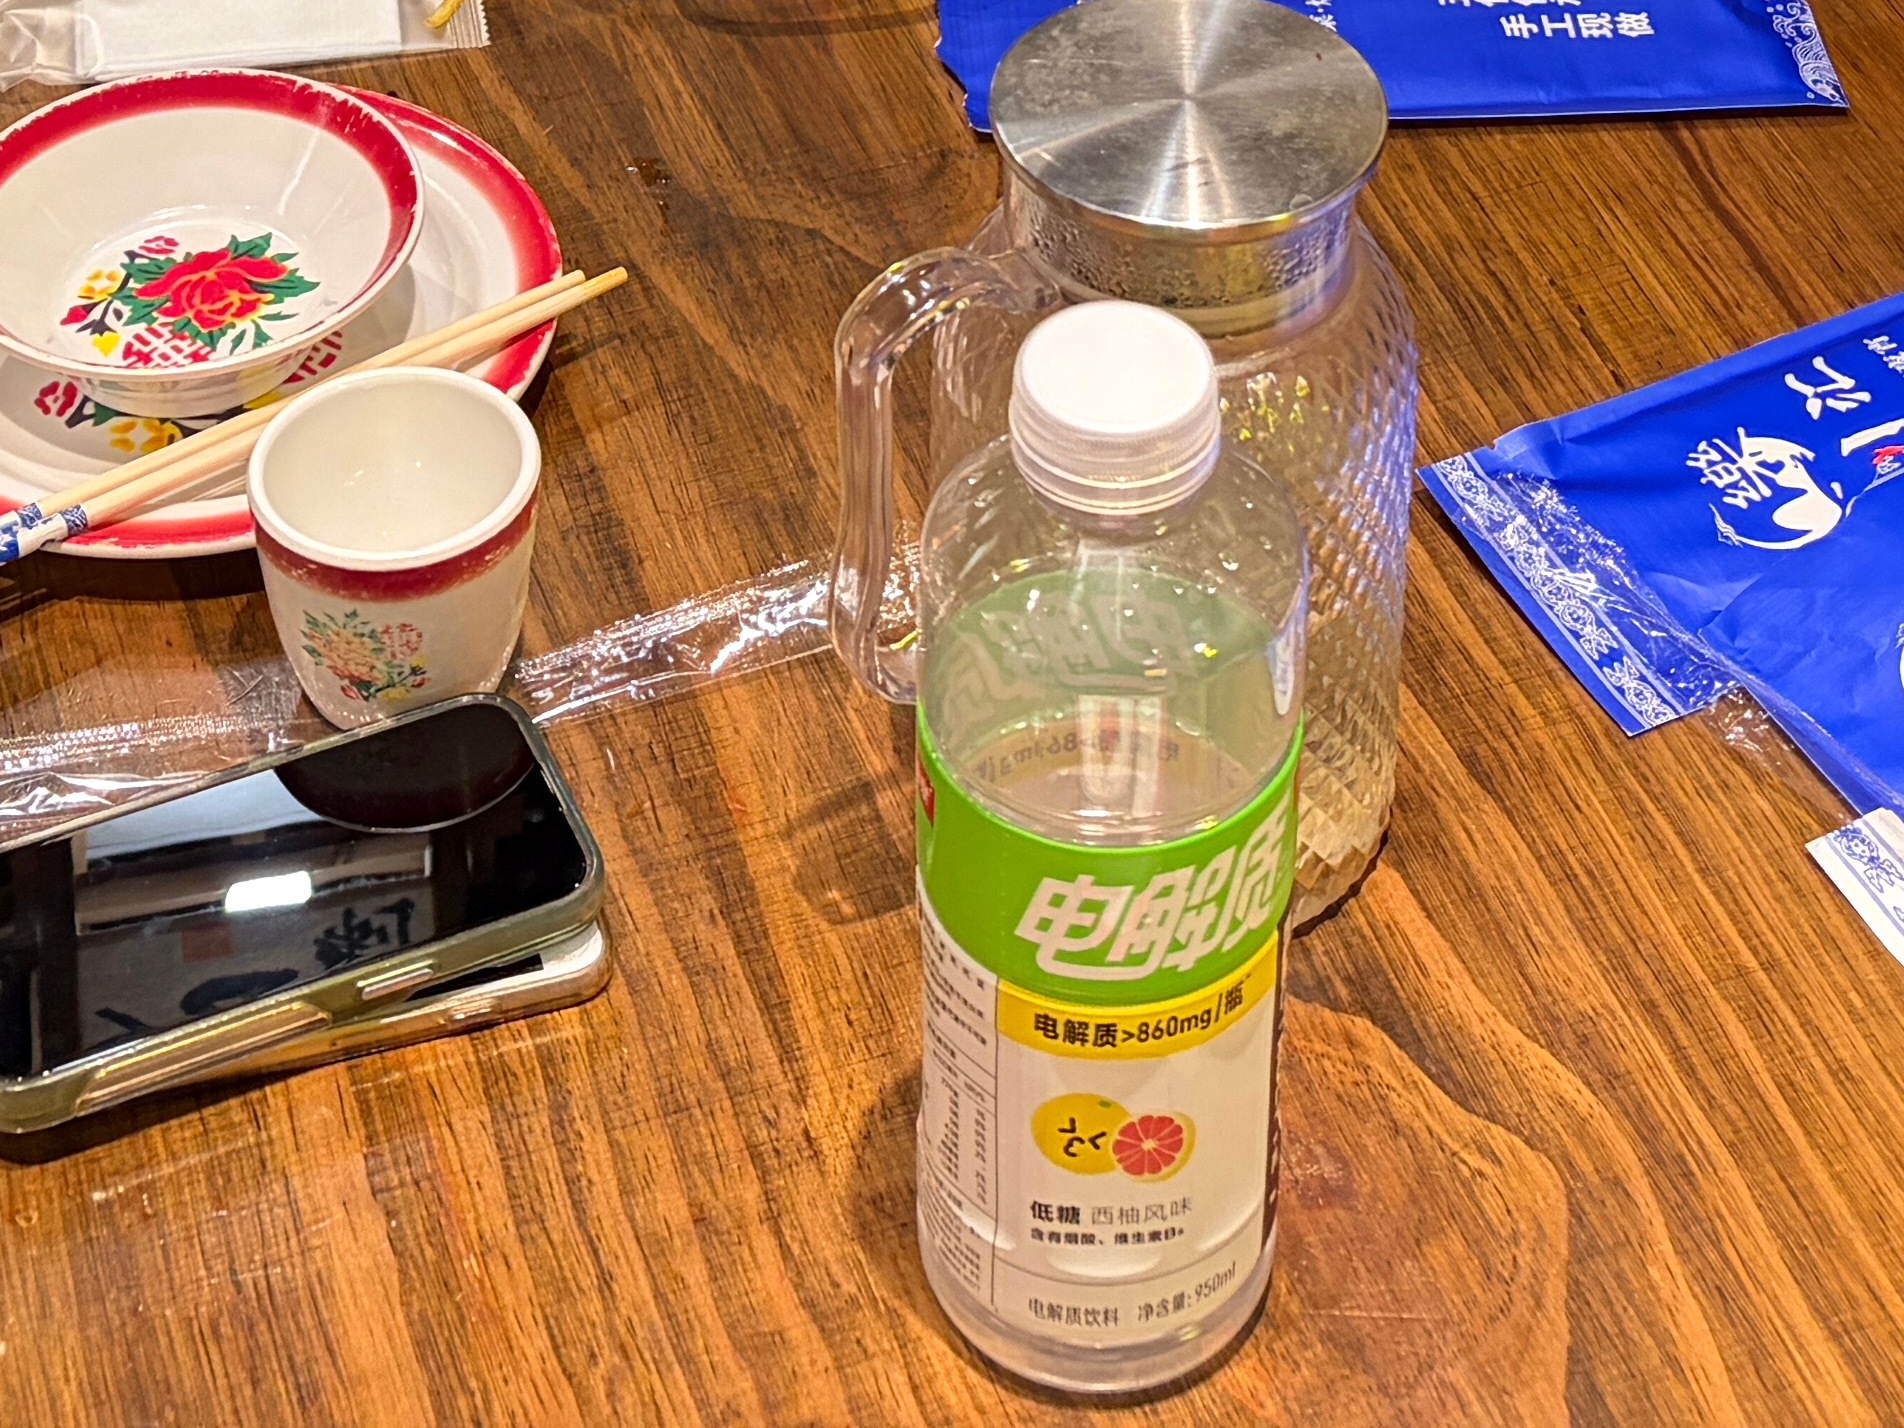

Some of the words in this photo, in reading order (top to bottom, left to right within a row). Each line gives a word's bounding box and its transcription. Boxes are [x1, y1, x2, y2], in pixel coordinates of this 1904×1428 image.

[1500, 10, 1656, 42] 手工现做
[1013, 796, 1289, 981] 电解质
[1030, 1199, 1082, 1226] 低糖
[1090, 1195, 1195, 1227] 西柚风味
[1028, 1297, 1120, 1328] 电解质饮料
